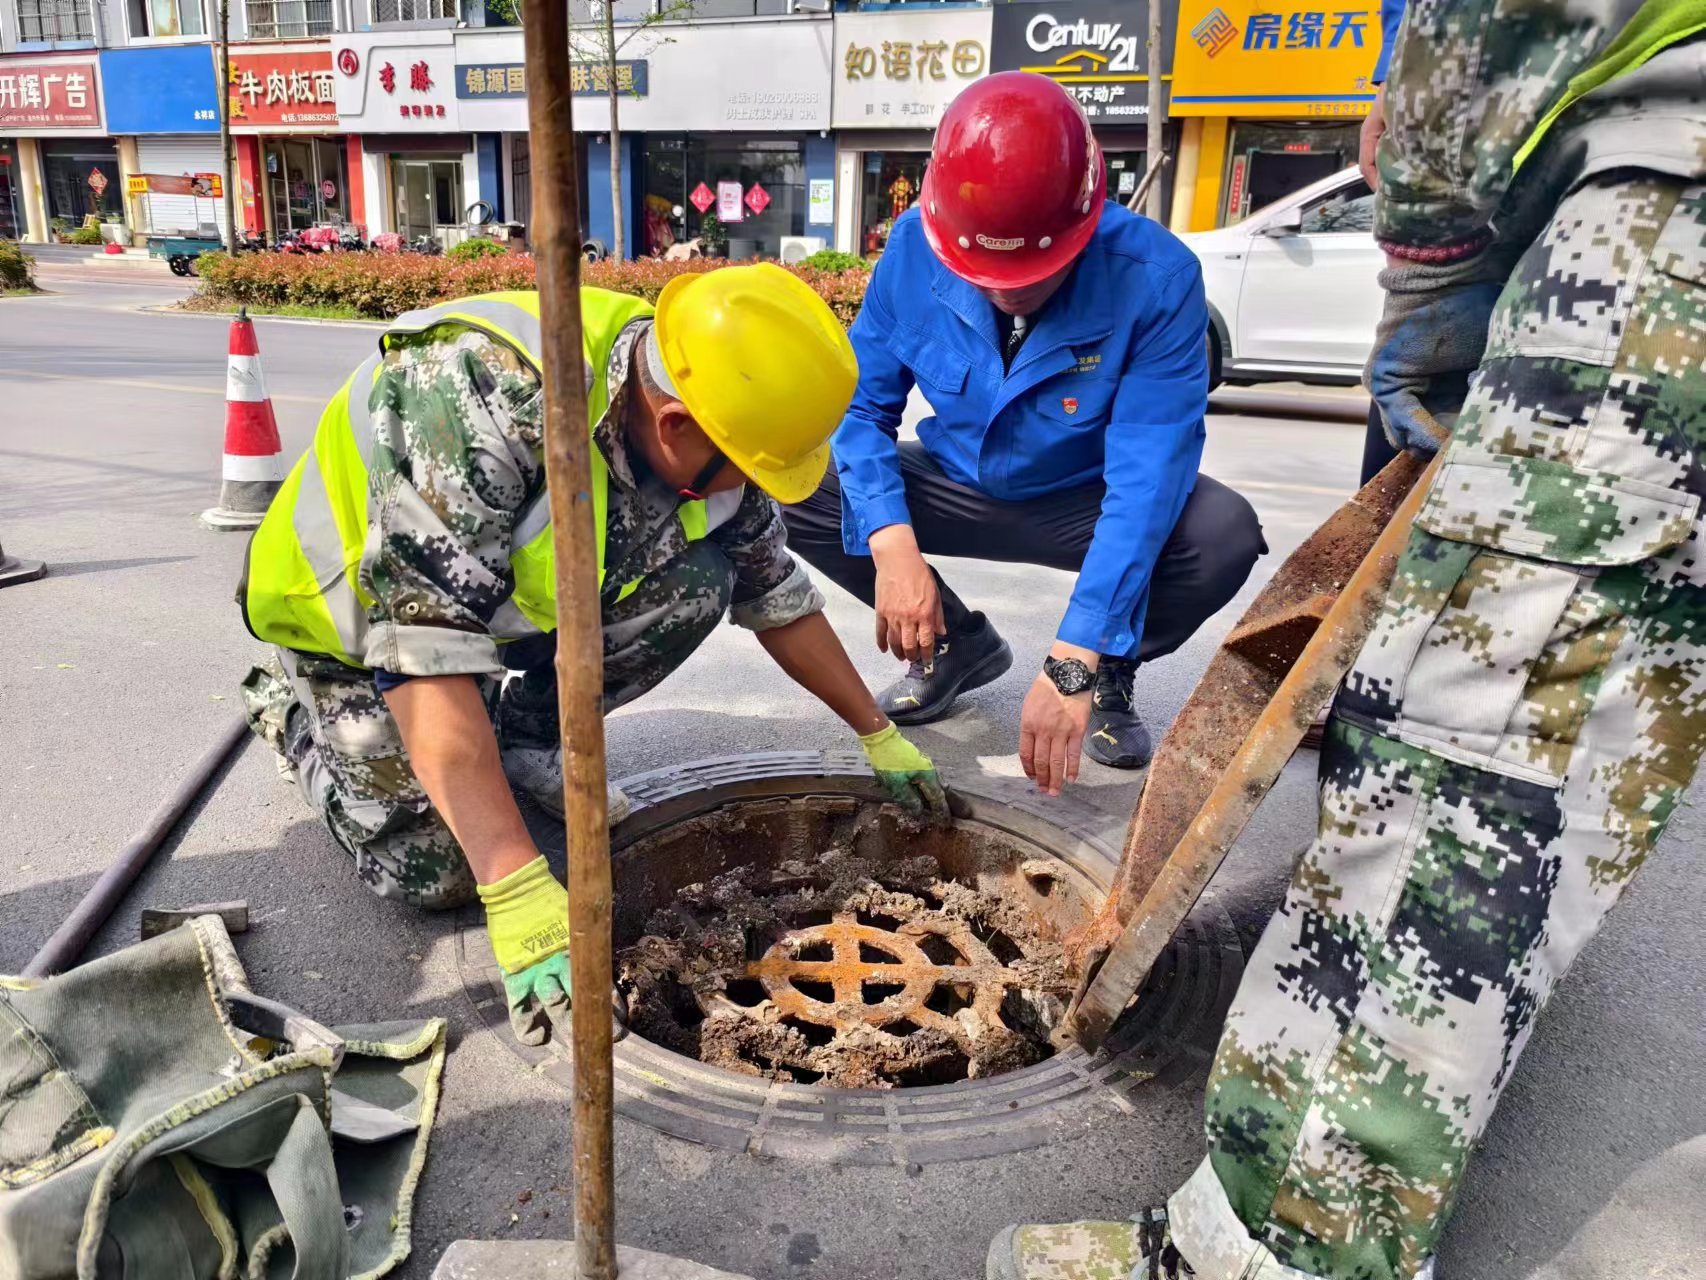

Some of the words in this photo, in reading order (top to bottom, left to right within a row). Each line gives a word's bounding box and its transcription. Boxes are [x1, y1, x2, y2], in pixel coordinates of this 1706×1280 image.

[1025, 13, 1121, 52] Century
[1108, 36, 1137, 71] 21
[1242, 12, 1380, 50] 房缘天
[465, 64, 634, 93] 锦源国肤管理
[845, 39, 985, 81] 知语花田
[239, 68, 336, 106] 牛肉板面
